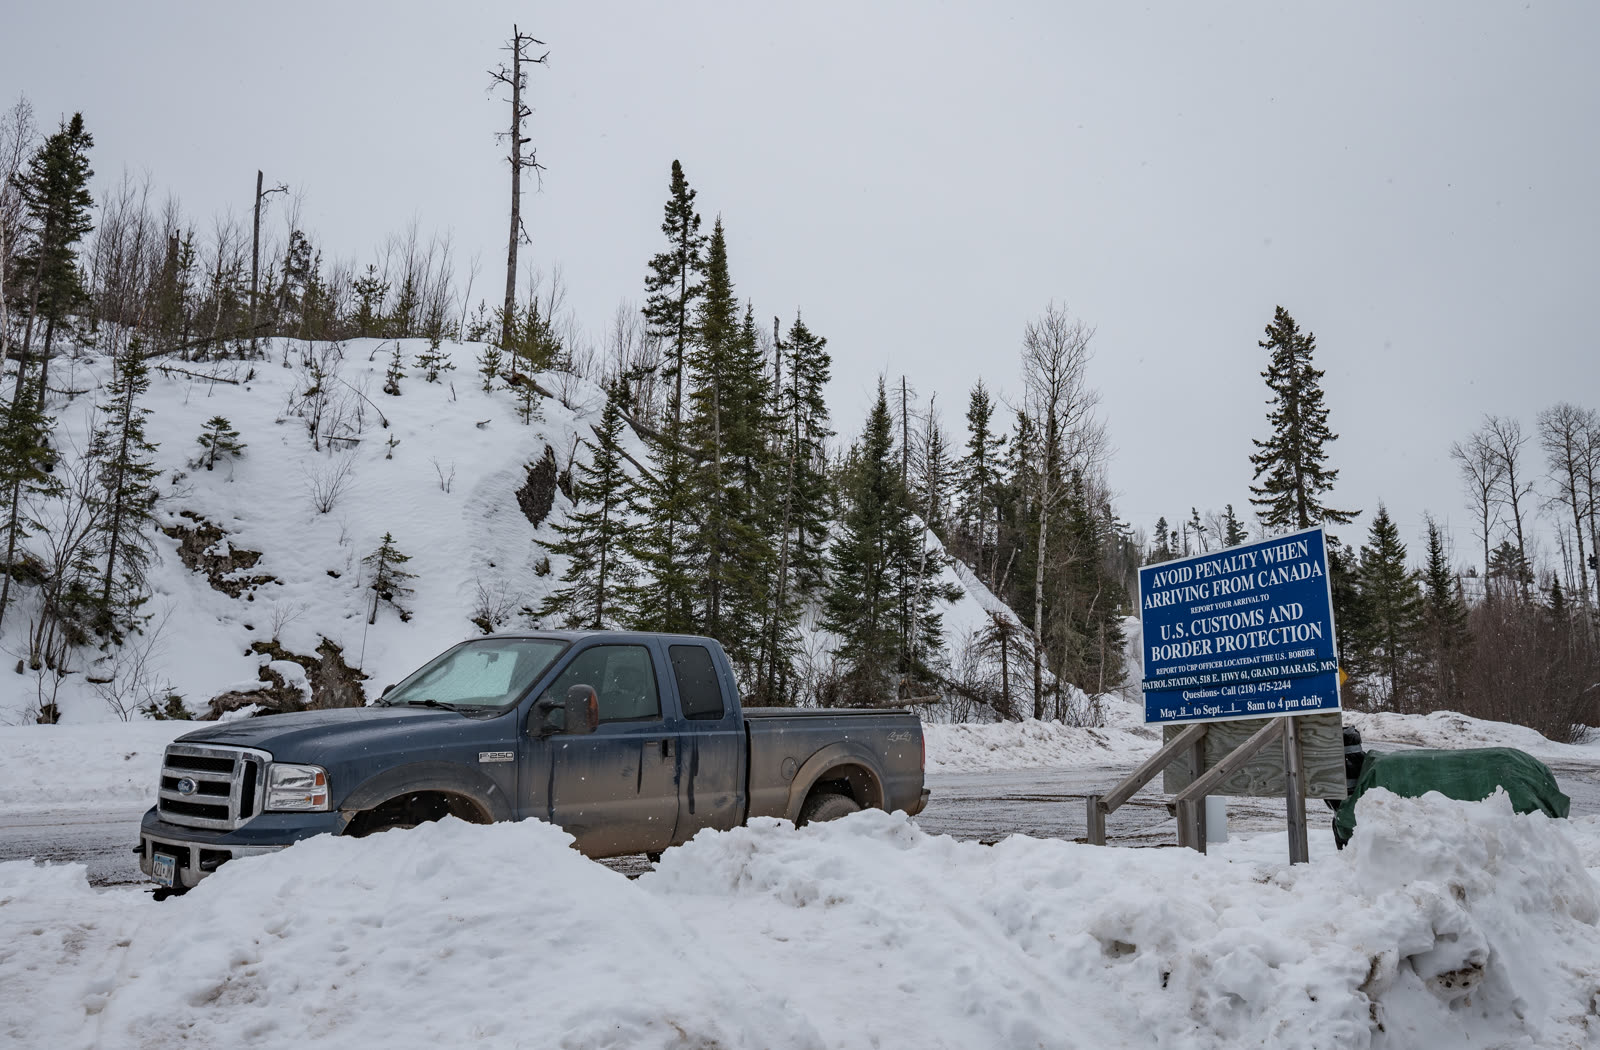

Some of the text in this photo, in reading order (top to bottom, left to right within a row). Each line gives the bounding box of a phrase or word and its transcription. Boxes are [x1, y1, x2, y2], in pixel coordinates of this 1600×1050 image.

[1152, 540, 1308, 588] AVOID PENALTY WHEN
[1144, 560, 1322, 610] ARRIVING FROM CANADA
[1190, 594, 1270, 614] REPORT YOUR ARRIVAL TO
[1160, 602, 1304, 640] U.S. CUSTOMS AND
[1152, 622, 1322, 662] BORDER PROTECTION
[1156, 666, 1177, 675] REPORT
[1199, 661, 1223, 670] OFFICER
[1224, 657, 1251, 666] LOCATED
[1288, 649, 1315, 658] BORDER
[1142, 680, 1167, 690] PATROL
[1168, 676, 1199, 687] STATION,
[1200, 674, 1210, 684] 518
[1212, 674, 1220, 682] E.
[1221, 672, 1240, 681] HWY
[1240, 671, 1250, 680] 61,
[1251, 667, 1279, 678] GRAND
[1281, 663, 1319, 675] MARAIS,
[1221, 686, 1236, 696] Call
[1238, 684, 1256, 695] (218)
[1258, 680, 1291, 692] 475-2244
[1160, 708, 1176, 719] May
[1194, 707, 1201, 715] to
[1203, 705, 1223, 716] Sept.
[1247, 701, 1265, 711] 8am
[1267, 701, 1276, 709] to
[1277, 697, 1283, 708] 4
[1285, 699, 1299, 710] pm
[1301, 695, 1322, 707] daily
